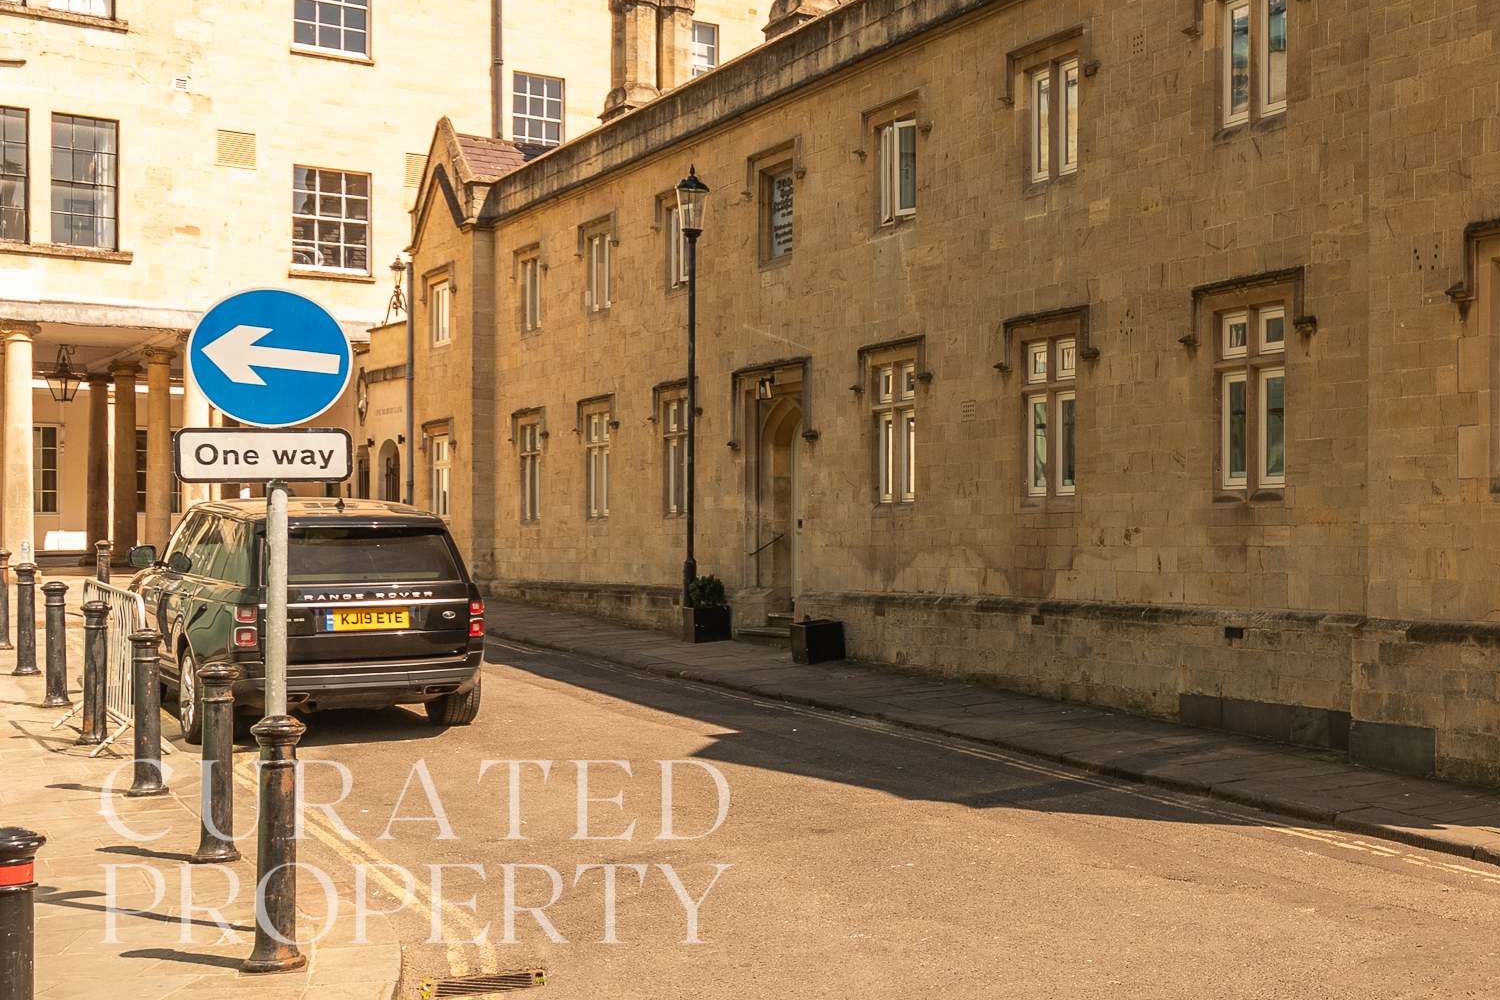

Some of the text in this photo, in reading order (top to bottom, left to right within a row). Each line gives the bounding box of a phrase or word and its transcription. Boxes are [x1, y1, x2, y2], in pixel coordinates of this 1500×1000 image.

[194, 443, 335, 469] One way
[303, 591, 433, 601] RANGE ROVER
[341, 611, 403, 625] KJ19 ETE
